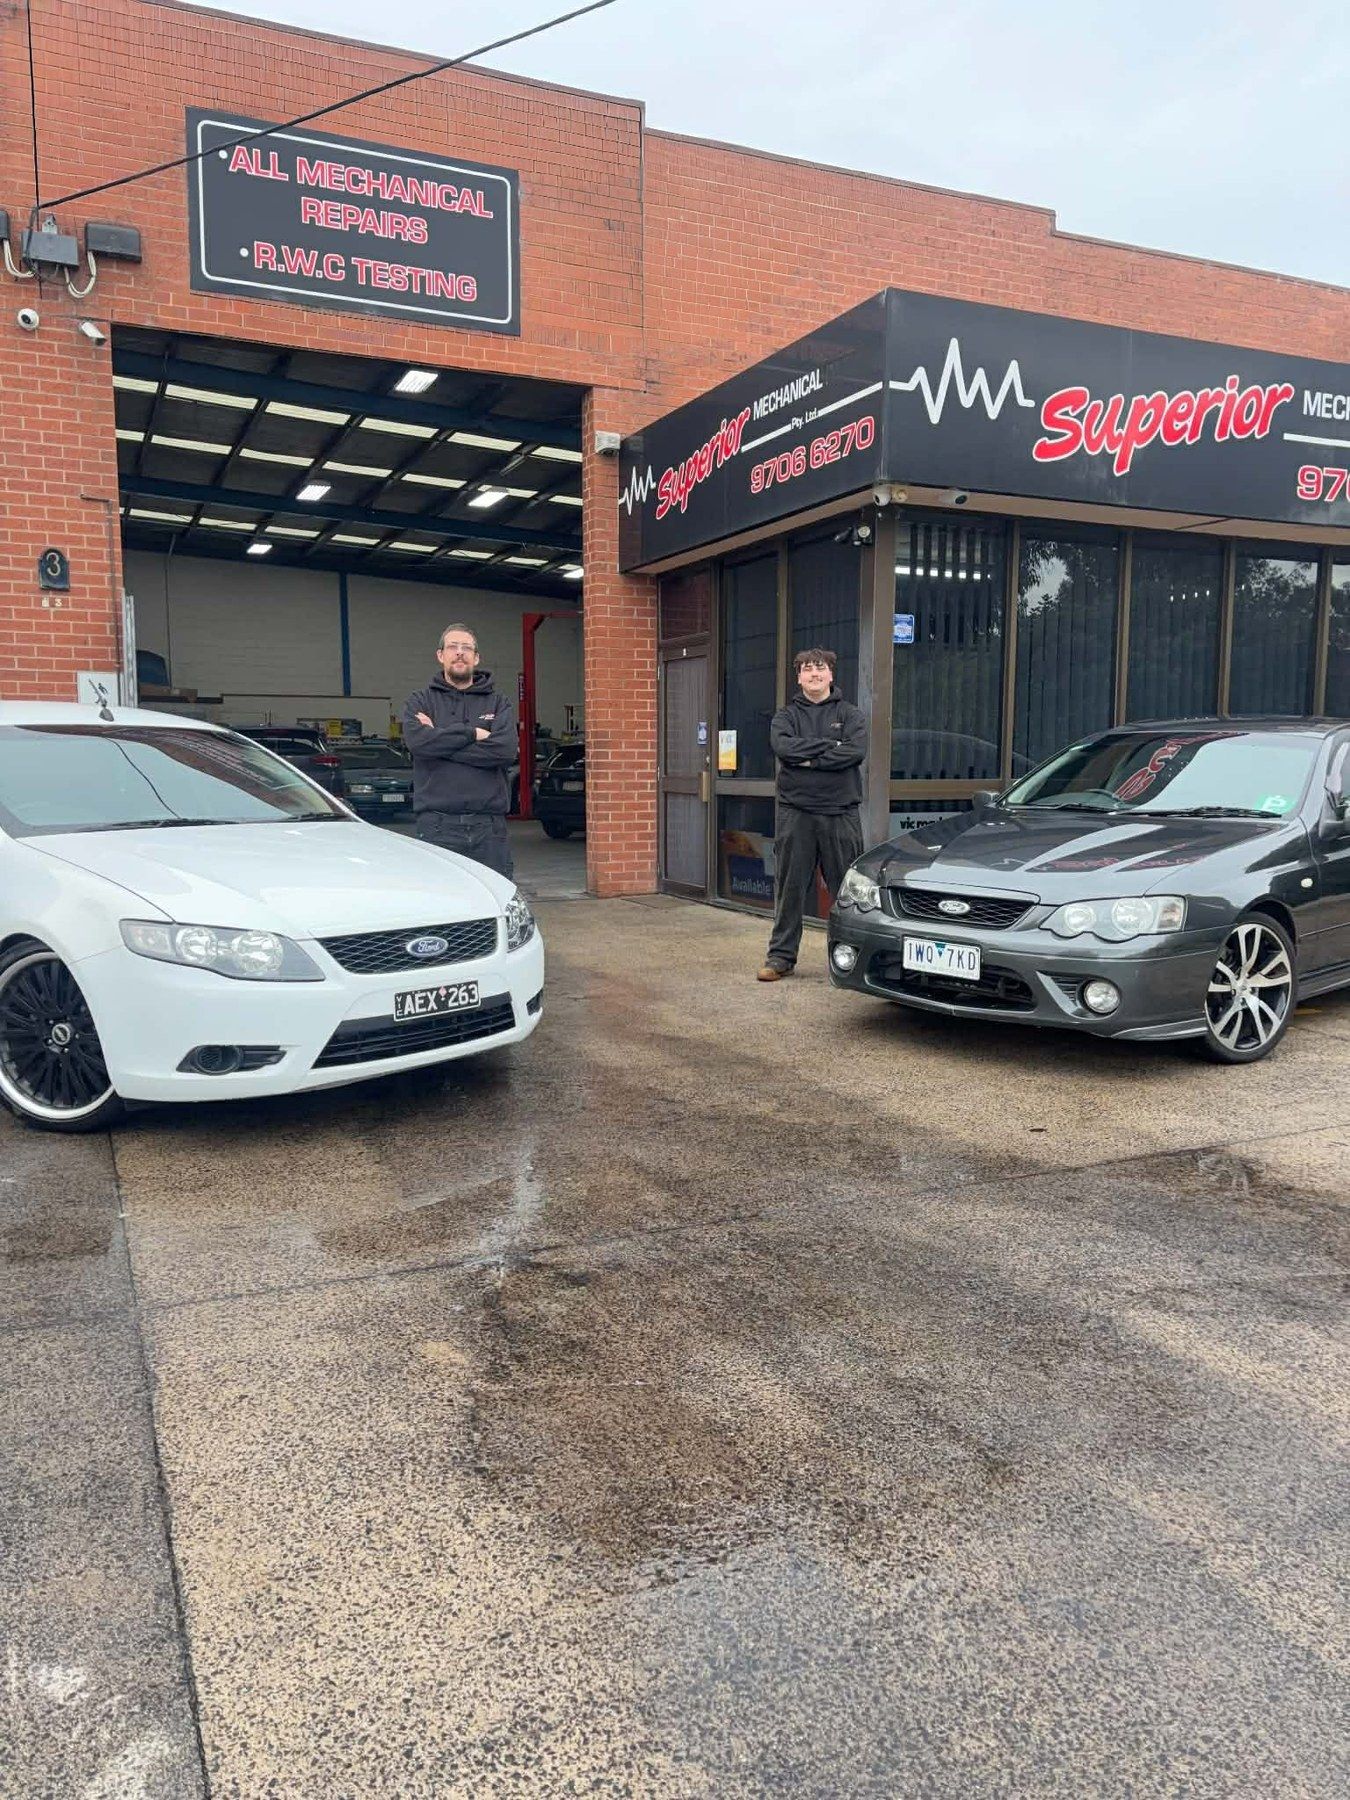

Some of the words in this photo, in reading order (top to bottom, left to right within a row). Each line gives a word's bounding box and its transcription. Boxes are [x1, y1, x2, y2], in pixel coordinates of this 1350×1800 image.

[228, 145, 289, 182] ALL
[296, 156, 494, 219] MECHANICAL
[300, 196, 429, 244] REPAIRS
[253, 241, 346, 282] R.W.C
[351, 257, 478, 302] TESTING
[655, 407, 751, 520] Superior
[753, 368, 824, 421] MECHANICAL
[1032, 375, 1295, 477] Superior
[750, 445, 806, 494] 9706
[809, 416, 875, 469] 6270
[1296, 464, 1350, 502] 97
[46, 552, 61, 576] 3
[417, 940, 440, 953] Ford
[404, 990, 438, 1015] AEX
[448, 983, 479, 1008] 263
